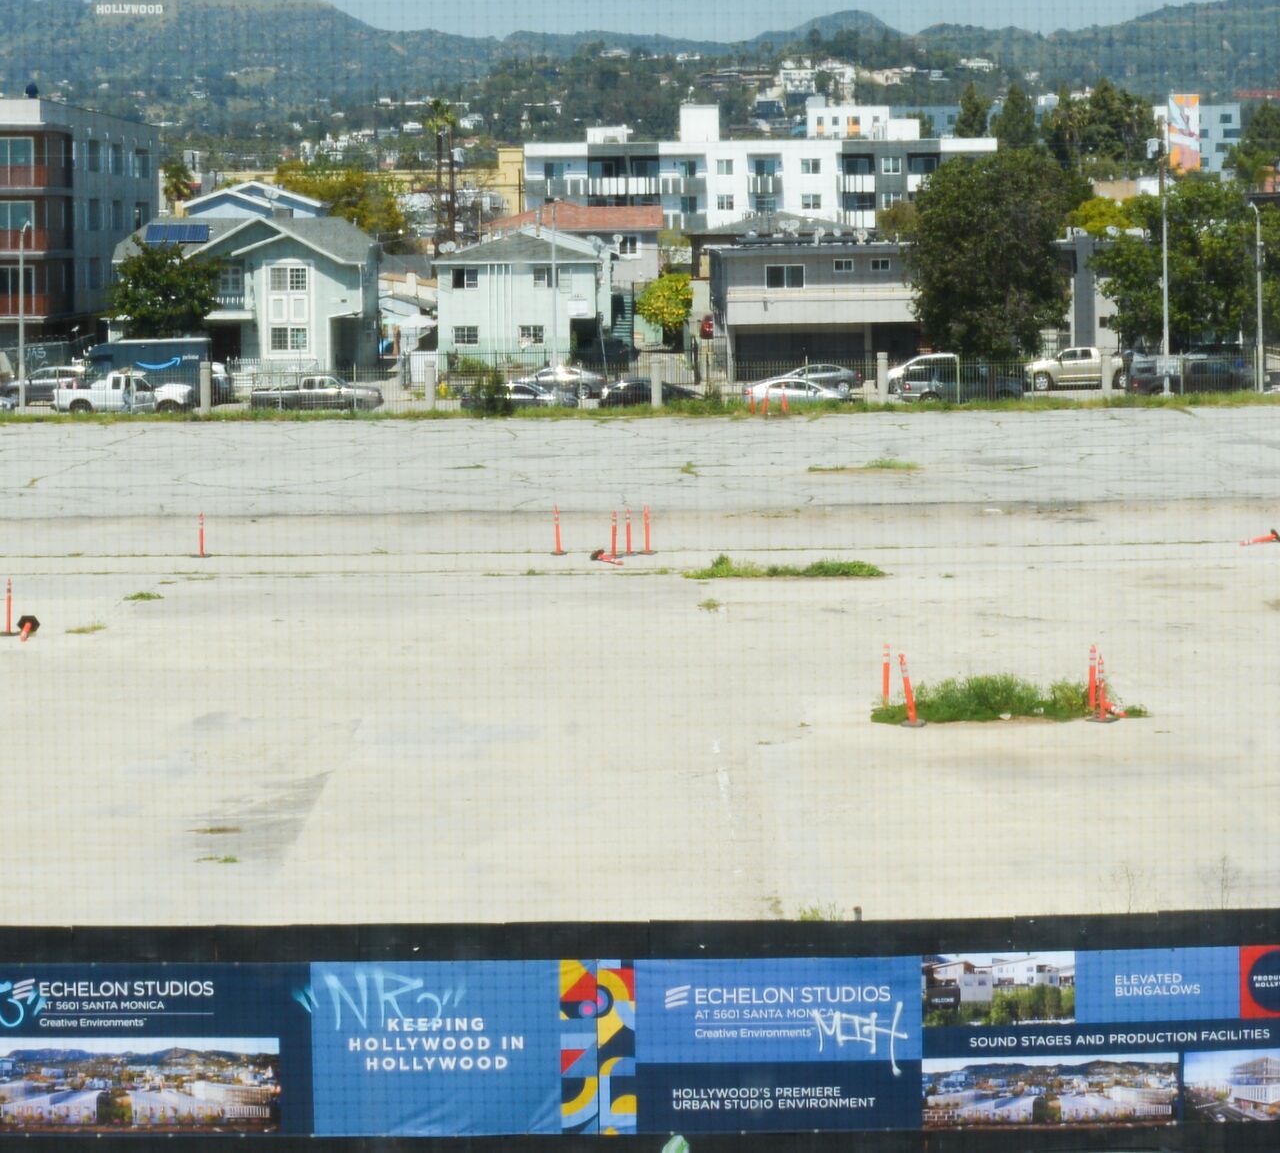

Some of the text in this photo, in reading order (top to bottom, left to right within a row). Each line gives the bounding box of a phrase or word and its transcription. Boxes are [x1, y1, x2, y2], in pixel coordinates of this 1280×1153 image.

[96, 4, 163, 14] HOLLYWOOD
[182, 353, 199, 361] prime
[1115, 973, 1182, 985] ELEVATED
[39, 980, 214, 997] ECHELON STUDIOS
[1115, 984, 1201, 997] BUNGALOWS
[695, 986, 891, 1005] ECHELON STUDIOS
[56, 1001, 80, 1010] 5601
[82, 1000, 118, 1010] SANTA
[120, 1000, 165, 1010] MONICA
[695, 1010, 709, 1020] AT
[713, 1009, 740, 1019] 5601
[743, 1009, 783, 1019] SANTA
[39, 1017, 144, 1028] Creative Environments
[387, 1018, 484, 1032] KEEPING
[695, 1027, 811, 1039] Creative Environments
[970, 1029, 1271, 1047] SOUND STAGES AND PRODUCTION FACILITIES
[349, 1036, 524, 1051] HOLLYWOOD IN
[367, 1055, 508, 1070] HOLLYWOOD
[673, 1086, 841, 1099] HOLLYWOOD'S PREMIERE
[673, 1097, 875, 1110] URBAN STUDIO ENVIRONMENT
